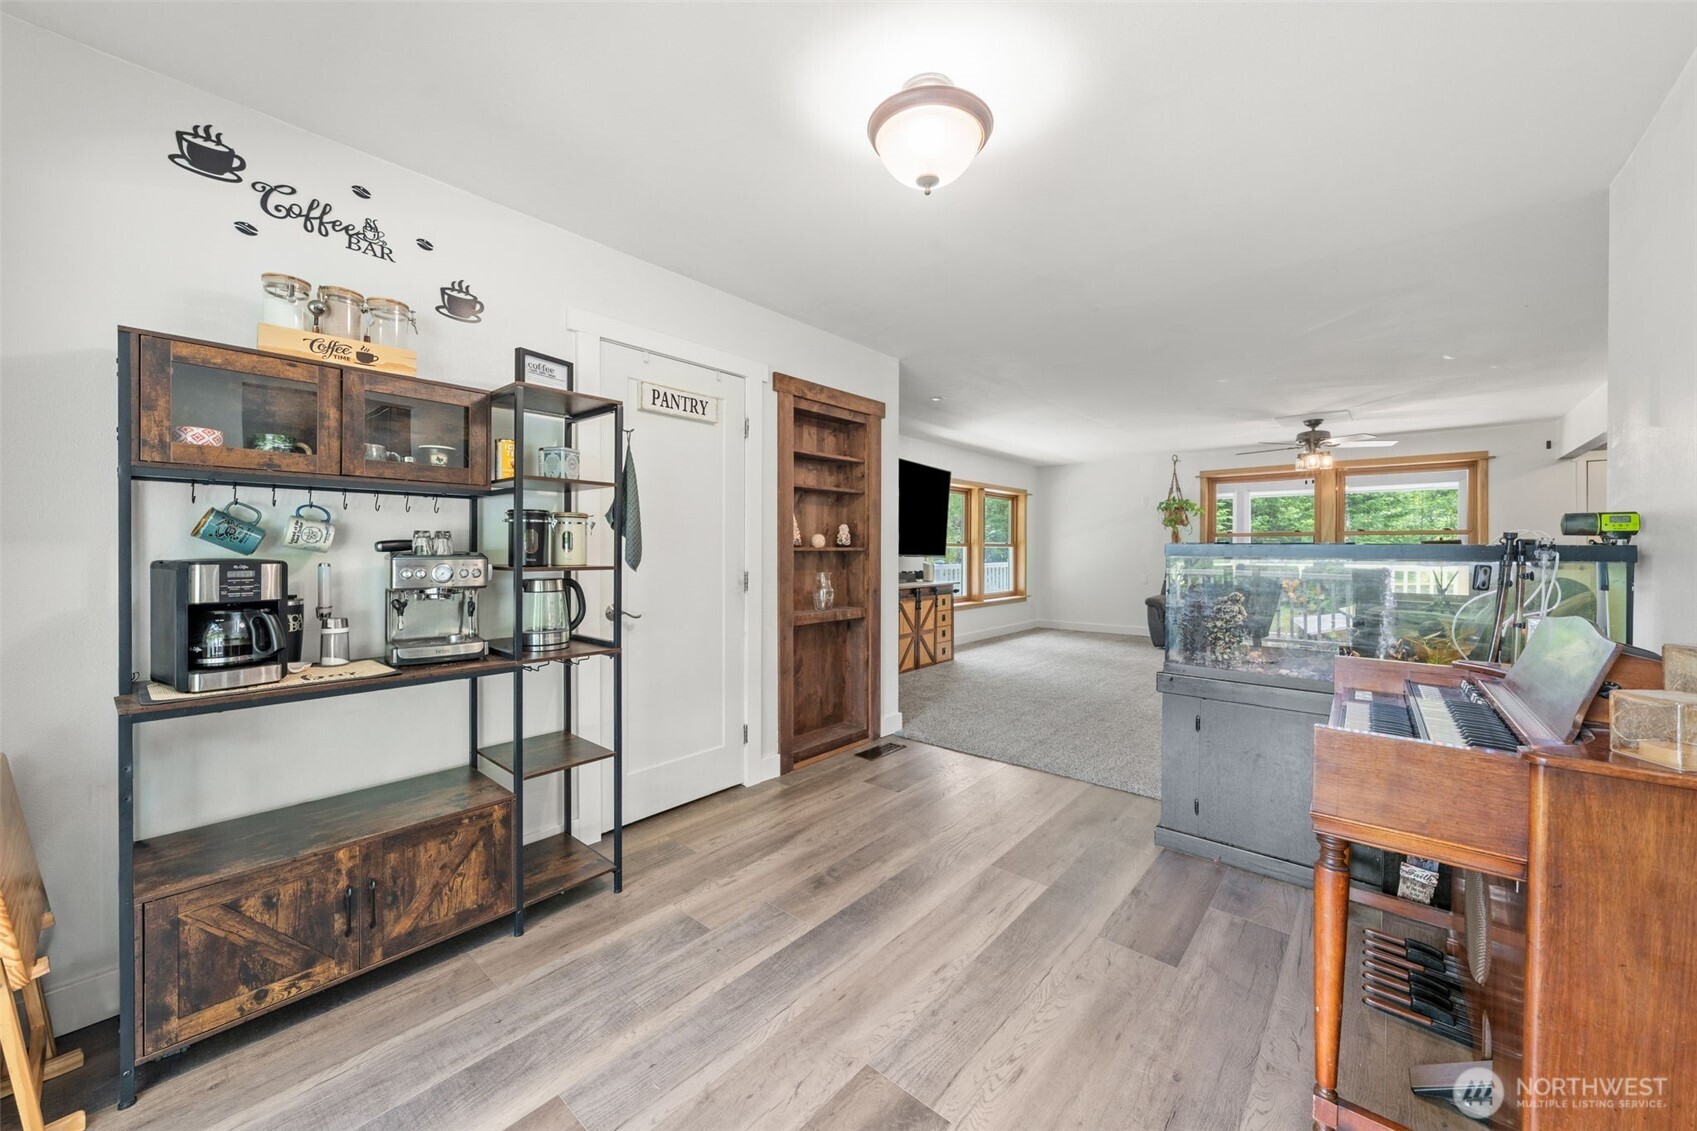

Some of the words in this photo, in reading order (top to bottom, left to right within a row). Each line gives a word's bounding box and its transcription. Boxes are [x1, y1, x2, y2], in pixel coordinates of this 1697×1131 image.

[251, 181, 362, 237] Coffee
[345, 236, 396, 263] BAR
[303, 338, 352, 359] Coffee
[651, 388, 709, 416] PANTRY
